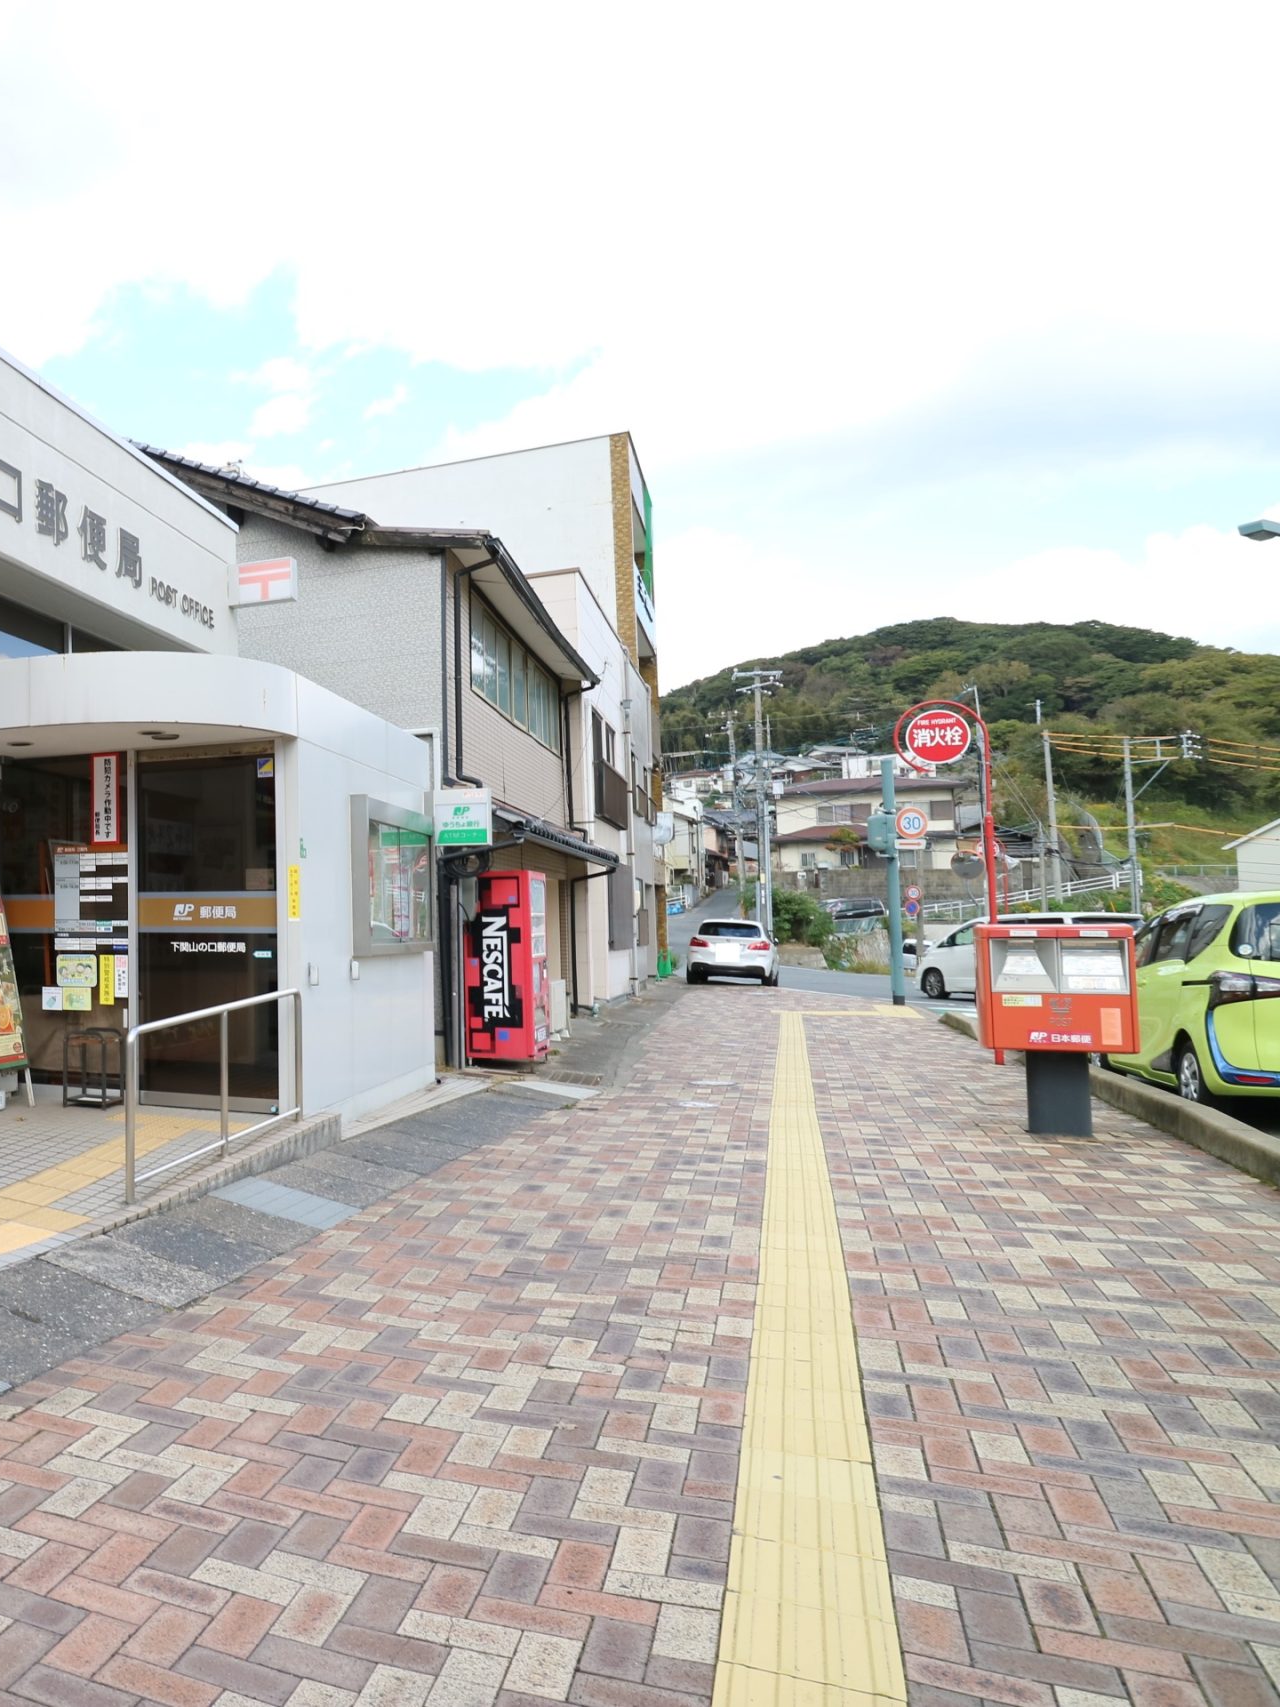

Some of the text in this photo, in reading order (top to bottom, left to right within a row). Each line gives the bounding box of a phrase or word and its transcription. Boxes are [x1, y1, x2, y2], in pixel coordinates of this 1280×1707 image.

[150, 576, 215, 629] POST OFFICE
[931, 717, 957, 725] HYDRANT
[912, 726, 963, 747] 消火栓
[903, 816, 921, 830] 30
[199, 906, 237, 919] 郵便局
[170, 941, 246, 953] 下関山の口郵便局
[1051, 1034, 1092, 1044] 日本郵便
